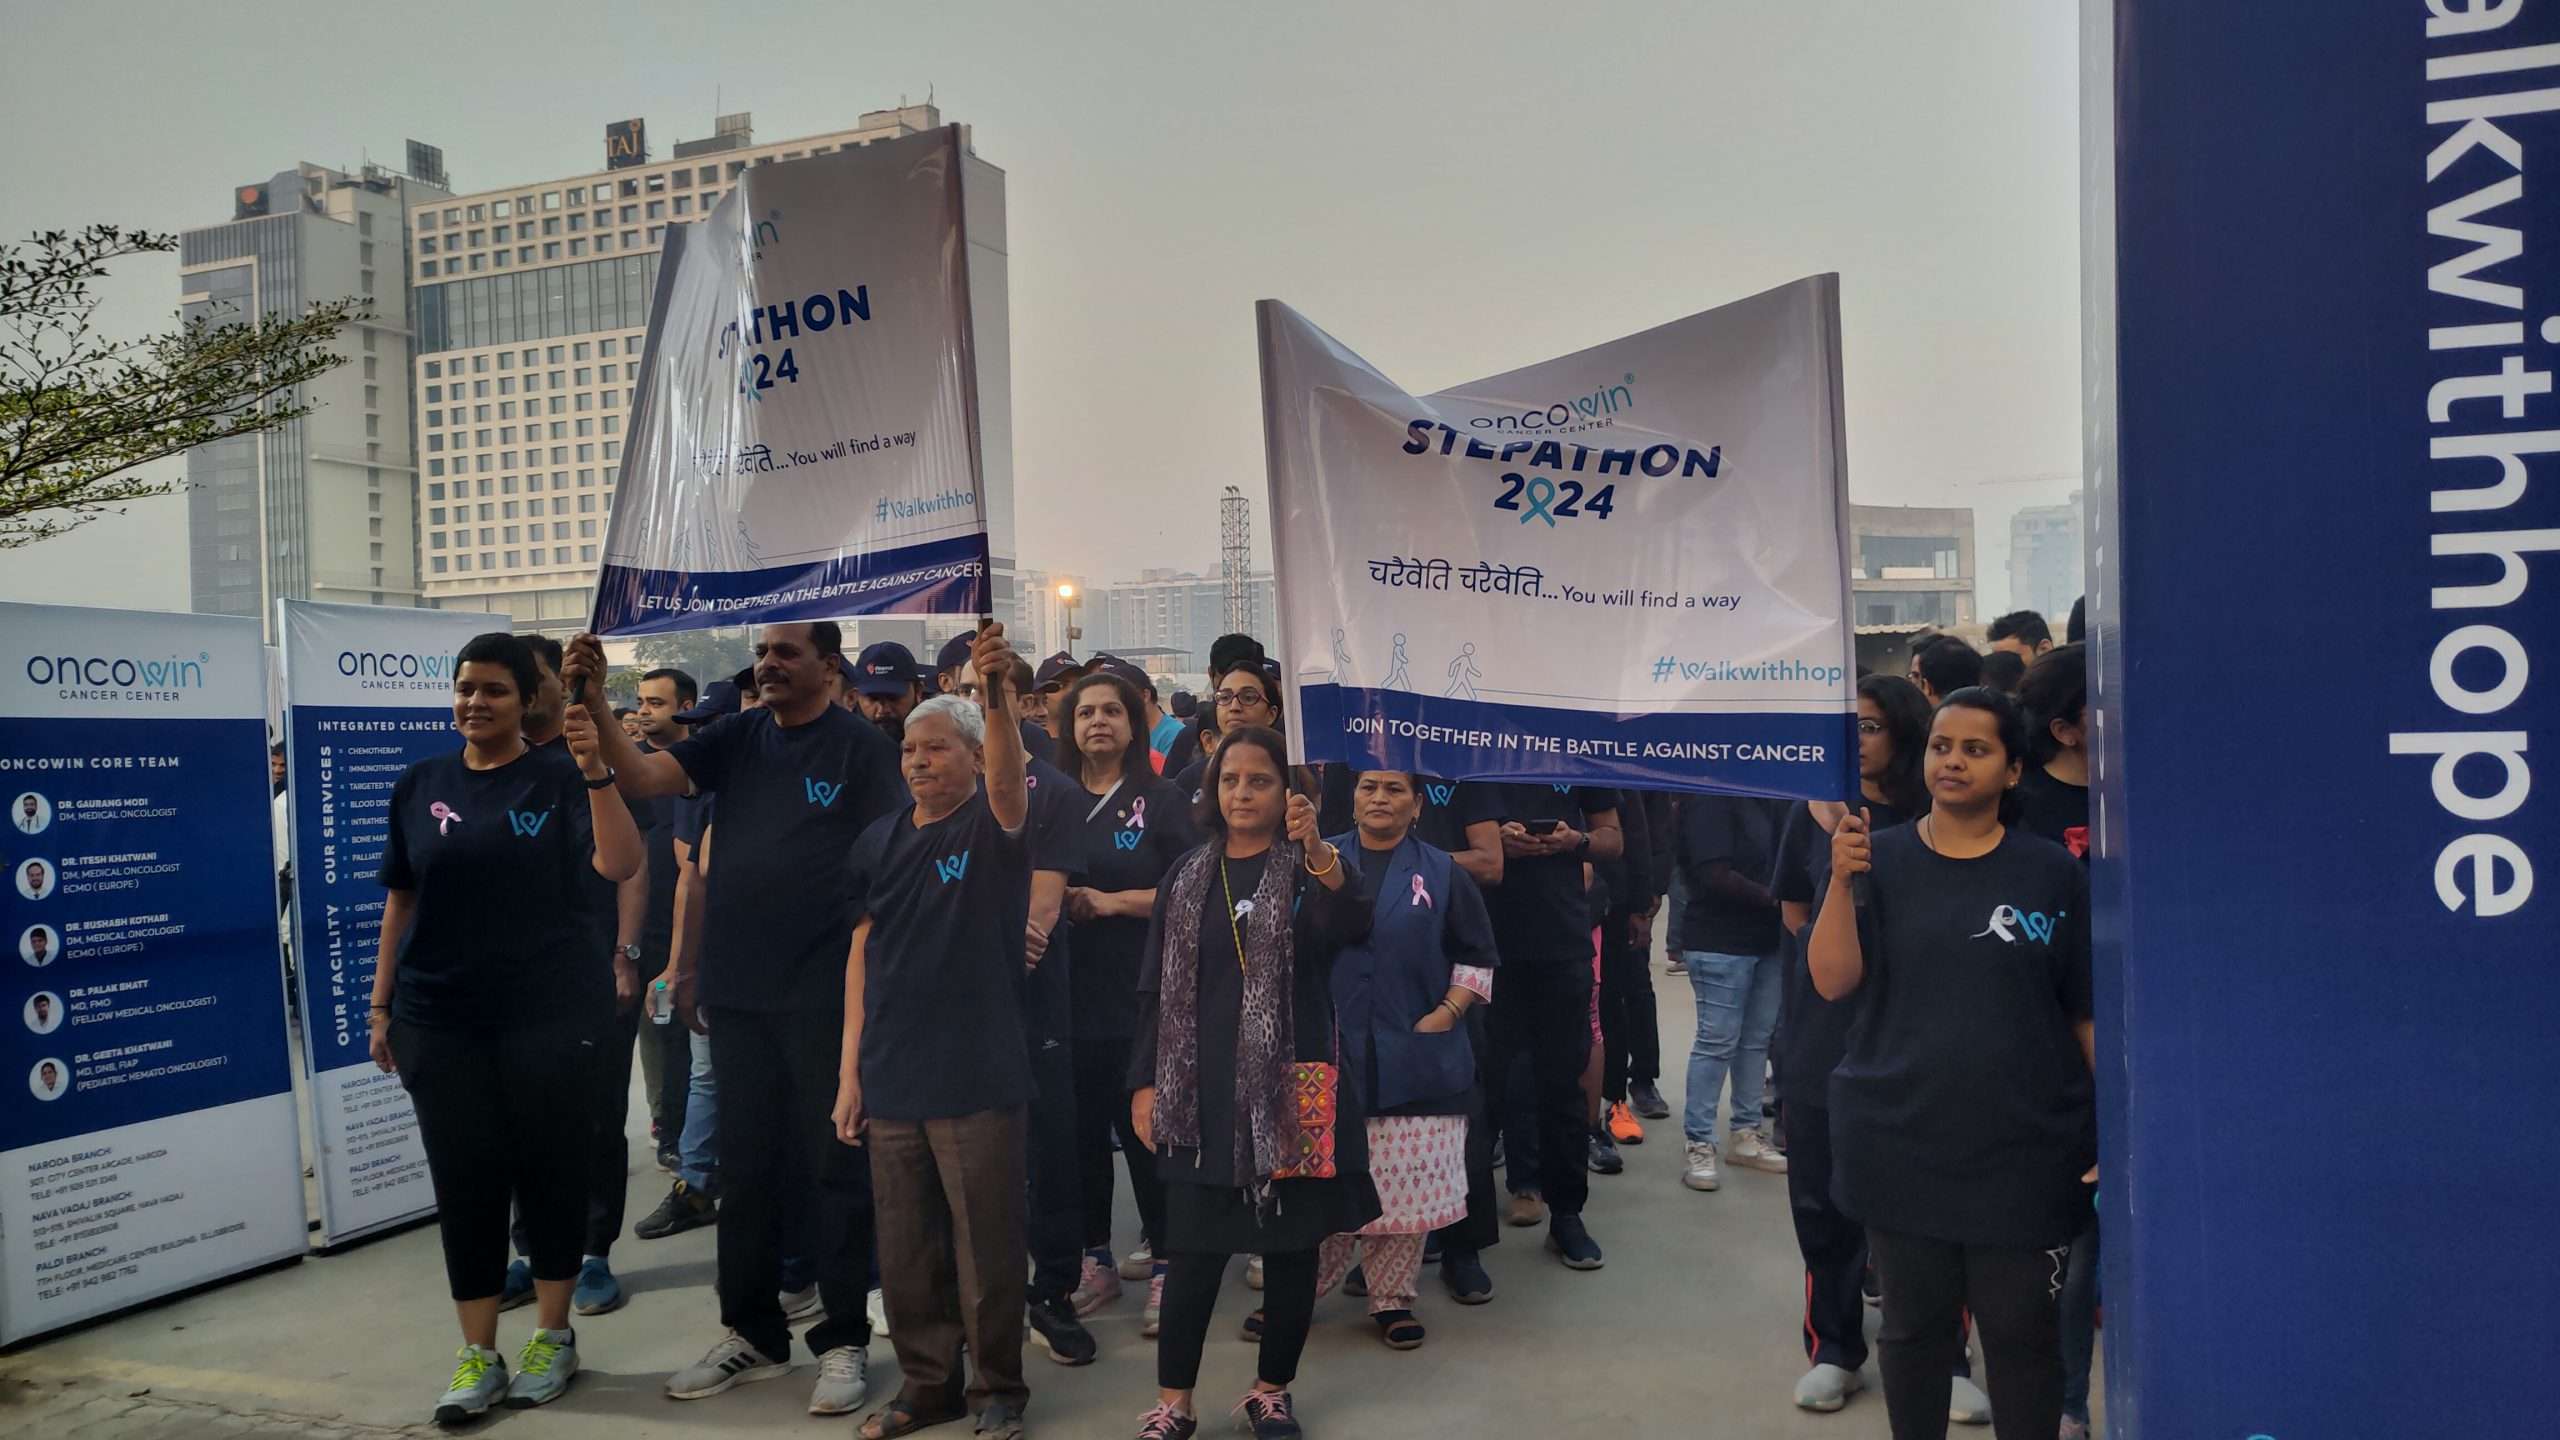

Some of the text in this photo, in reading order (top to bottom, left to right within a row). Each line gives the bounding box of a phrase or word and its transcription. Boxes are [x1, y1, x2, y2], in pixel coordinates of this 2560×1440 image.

[606, 130, 639, 158] TAJ
[1559, 418, 1614, 434] CENTER
[787, 451, 817, 467] You
[821, 442, 847, 462] will
[850, 434, 880, 455] find
[883, 438, 891, 448] a
[893, 431, 916, 448] way
[876, 488, 976, 522] #Walkwithho
[640, 561, 983, 612] LET US JOIN TOGETHER IN THE BATTLE AGAINST CANCER
[1368, 556, 1452, 591] चरैवेति
[1602, 589, 1633, 606] will
[1641, 590, 1677, 608] find
[1685, 597, 1695, 608] a
[1703, 595, 1741, 612] way
[1652, 656, 1846, 687] #Walkwithhop
[362, 681, 450, 690] CANCER CENTER
[59, 690, 180, 702] CANCER CENTER
[318, 721, 395, 731] INTEGRATED
[400, 721, 446, 731] CANCER
[1346, 717, 1825, 763] JOIN TOGETHER IN THE BATTLE AGAINST CANCER
[347, 747, 403, 755] CHEMOTHERAPY
[0, 756, 180, 770] ONCOWIN CORE TEAM
[349, 781, 385, 791] TARGETED
[76, 799, 122, 809] GAURANG
[124, 798, 148, 806] MODI
[350, 800, 375, 808] BLOOD
[78, 811, 120, 821] MEDICAL
[120, 808, 177, 818] ONCOLOGIST
[320, 746, 337, 884] OUR SERVICES
[351, 817, 389, 826] INTRATHEC
[80, 855, 107, 865] ITESH
[108, 852, 157, 864] KHATWANI
[352, 852, 383, 861] PALLIAT
[82, 868, 123, 879] MEDICAL
[123, 863, 180, 875] ONCOLOGIST
[353, 870, 379, 879] PEDIAT
[63, 884, 92, 894] ECMO
[129, 913, 168, 925] KOTHARI
[356, 920, 382, 929] PREVEN
[86, 932, 127, 944] MEDICAL
[127, 925, 185, 938] ONCOLOGIST
[67, 949, 96, 959] ECMO
[326, 904, 350, 1046] OUR FACILITY
[87, 983, 119, 995] PALAK
[115, 1004, 155, 1018] MEDICAL
[92, 1048, 123, 1060] GEETA
[28, 1157, 70, 1172] NARODA
